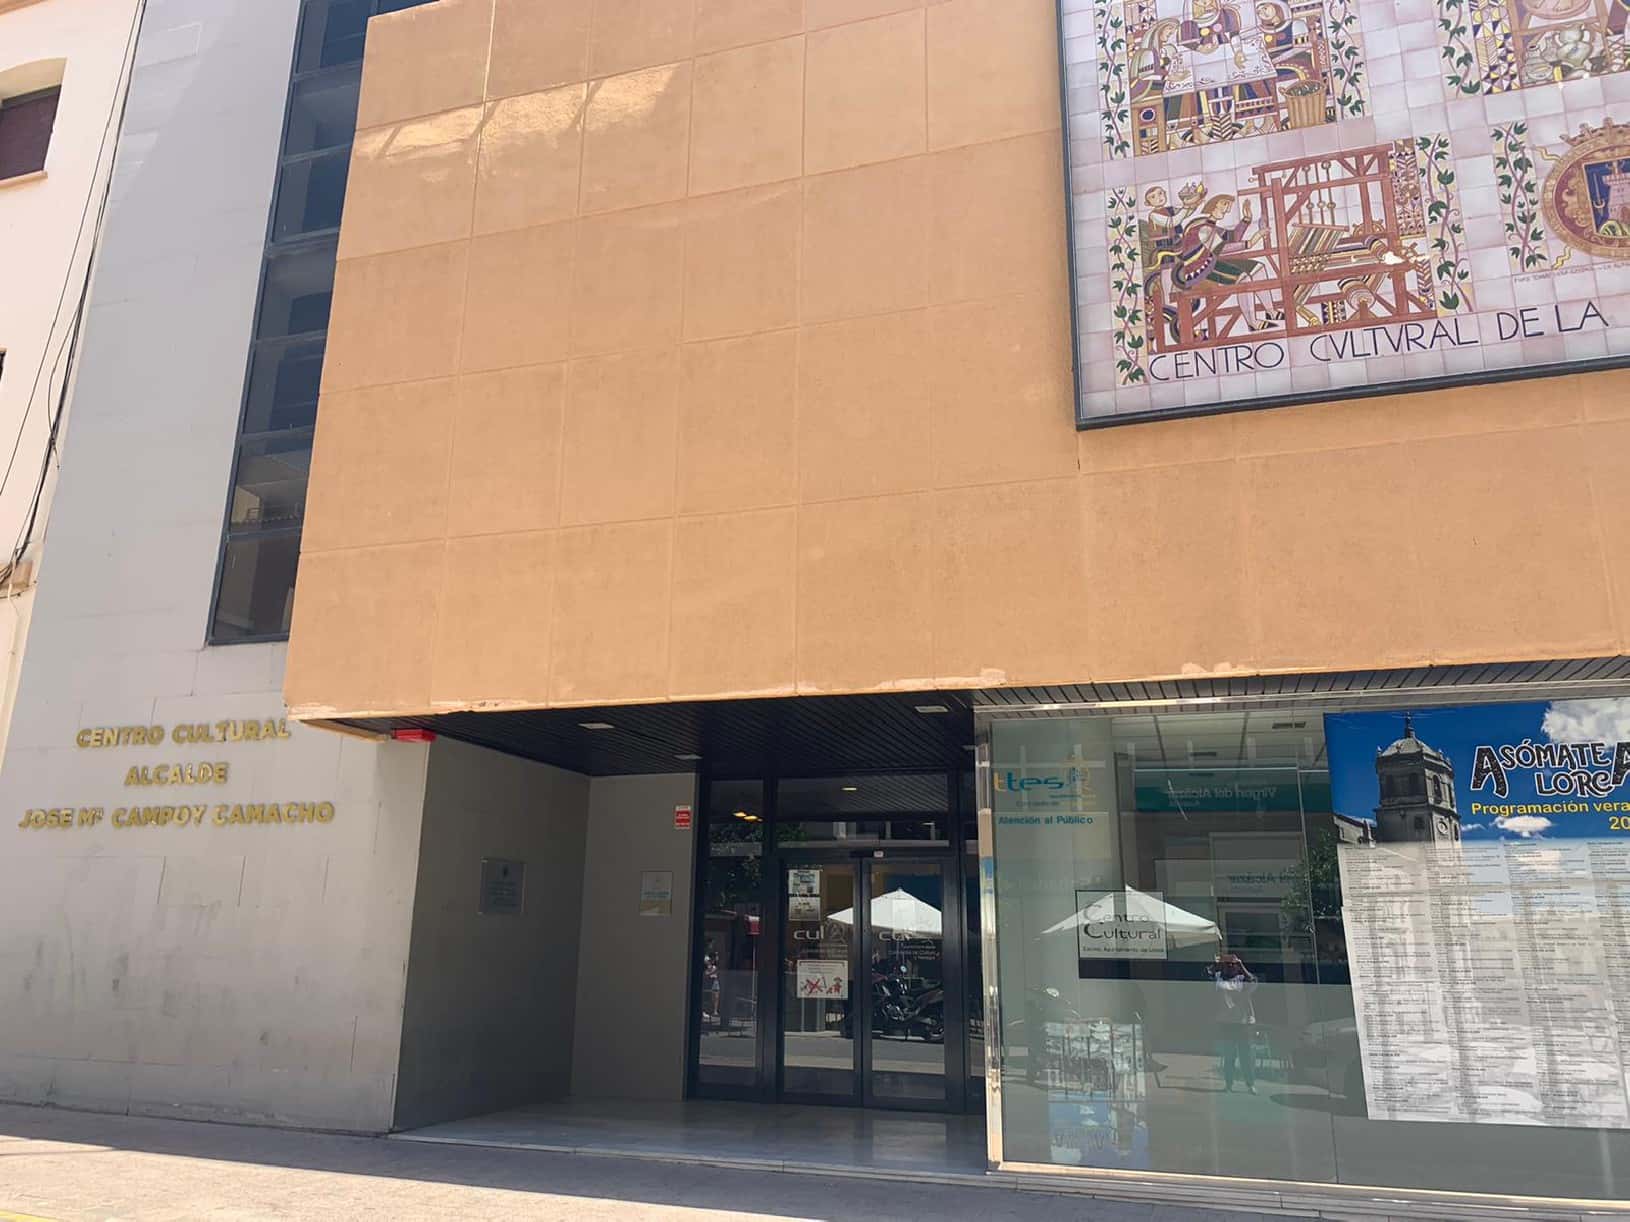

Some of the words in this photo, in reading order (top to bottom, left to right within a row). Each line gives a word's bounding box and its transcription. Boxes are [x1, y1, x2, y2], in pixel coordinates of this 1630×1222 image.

[1149, 342, 1285, 382] CENTRO
[1309, 322, 1479, 362] CVLTVRAL
[1497, 307, 1545, 341] DE
[1554, 301, 1609, 333] LA
[76, 725, 166, 748] CENTRO
[172, 718, 291, 744] CULTURAL
[124, 762, 229, 786] ALCALDE
[18, 807, 74, 829] JOSE
[111, 804, 206, 828] CAMPOY
[212, 801, 336, 826] CAMACHO
[998, 815, 1041, 825] Atención
[1044, 815, 1053, 825] al
[1056, 814, 1094, 825] Público
[1471, 799, 1589, 817] Programación
[1083, 922, 1162, 940] Cultural
